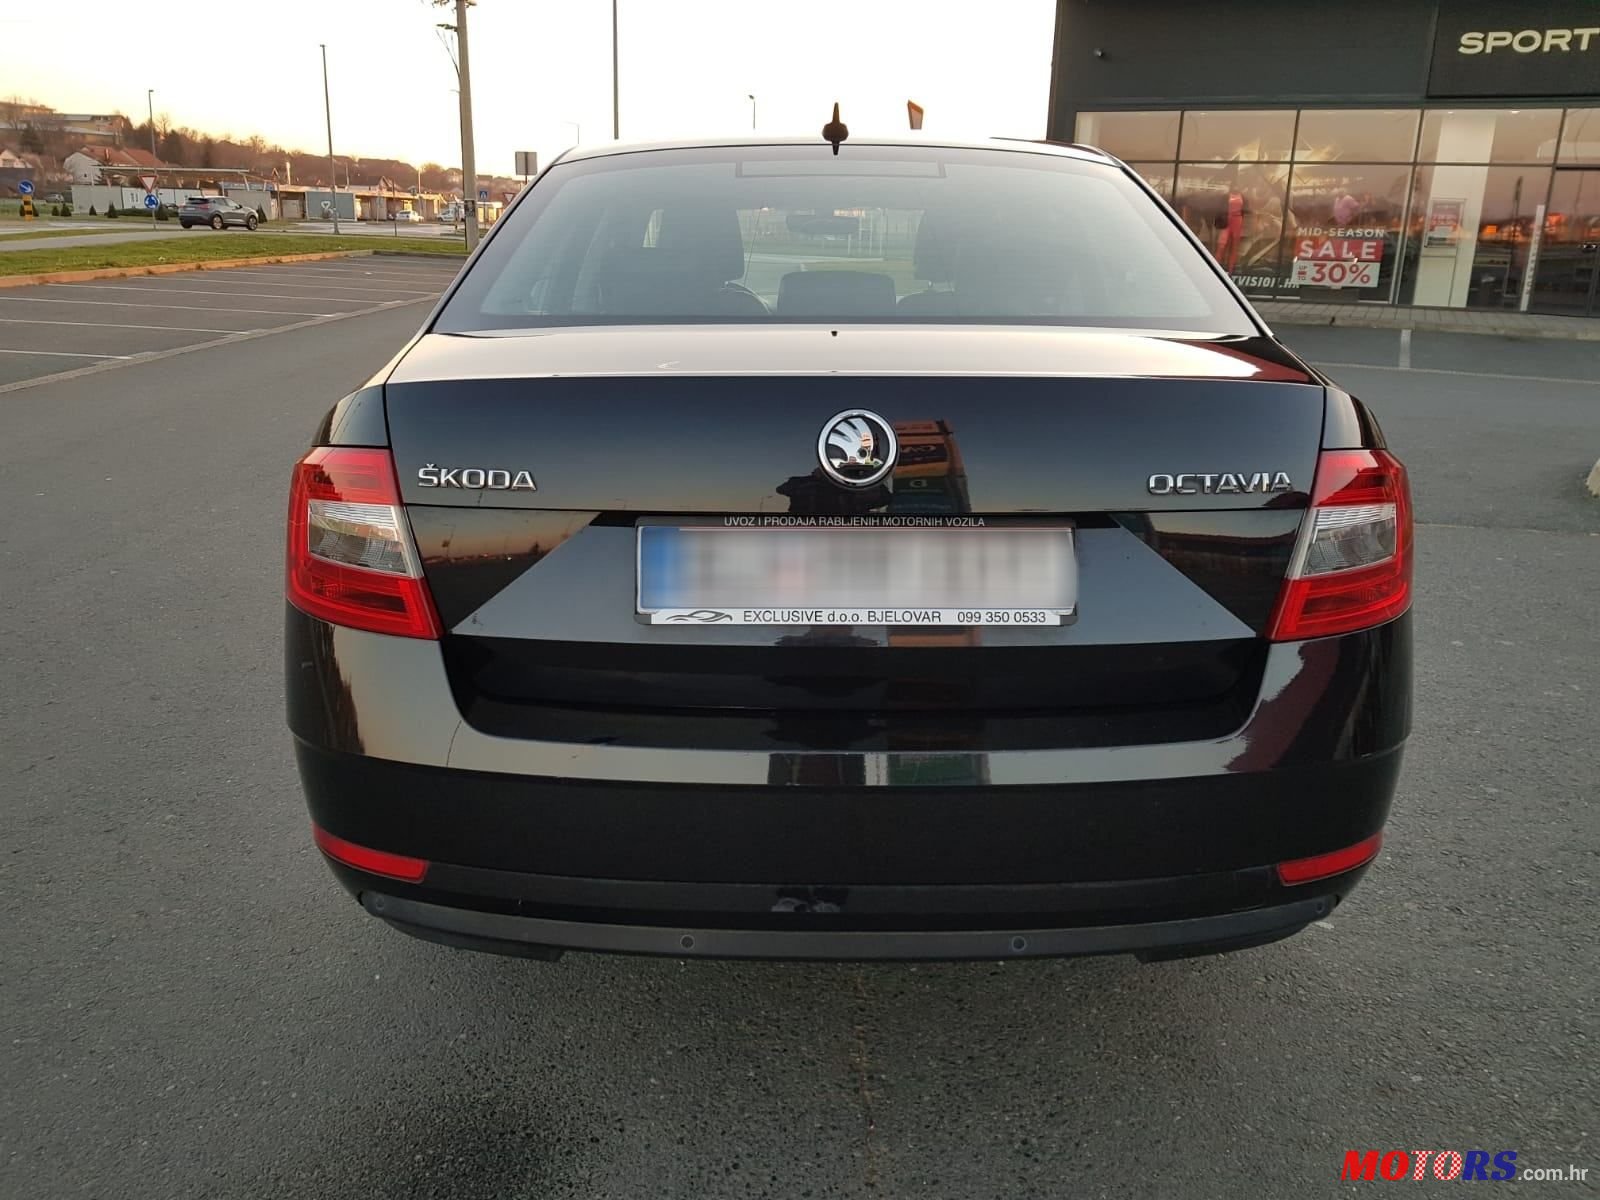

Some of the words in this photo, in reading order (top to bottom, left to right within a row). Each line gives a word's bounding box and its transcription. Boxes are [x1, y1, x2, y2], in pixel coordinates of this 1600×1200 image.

[1458, 27, 1600, 55] SPORT
[1297, 227, 1385, 238] MID-SEASON
[1299, 240, 1377, 259] SALE
[1311, 262, 1371, 284] 30%
[418, 463, 537, 490] ŠKODA
[1149, 472, 1292, 494] OCTAVIA
[724, 516, 755, 527] UVOZ
[764, 516, 817, 527] PRODAJA
[819, 516, 880, 527] RABLJENIH
[882, 516, 943, 527] MOTORNIH
[945, 517, 985, 527] VOZILA
[743, 610, 824, 623] EXCLUSIVE
[827, 610, 864, 623] d.o.o.
[867, 610, 942, 623] BJELOVAR
[957, 611, 982, 623] 099
[985, 611, 1010, 623] 350
[1013, 611, 1047, 623] 0533
